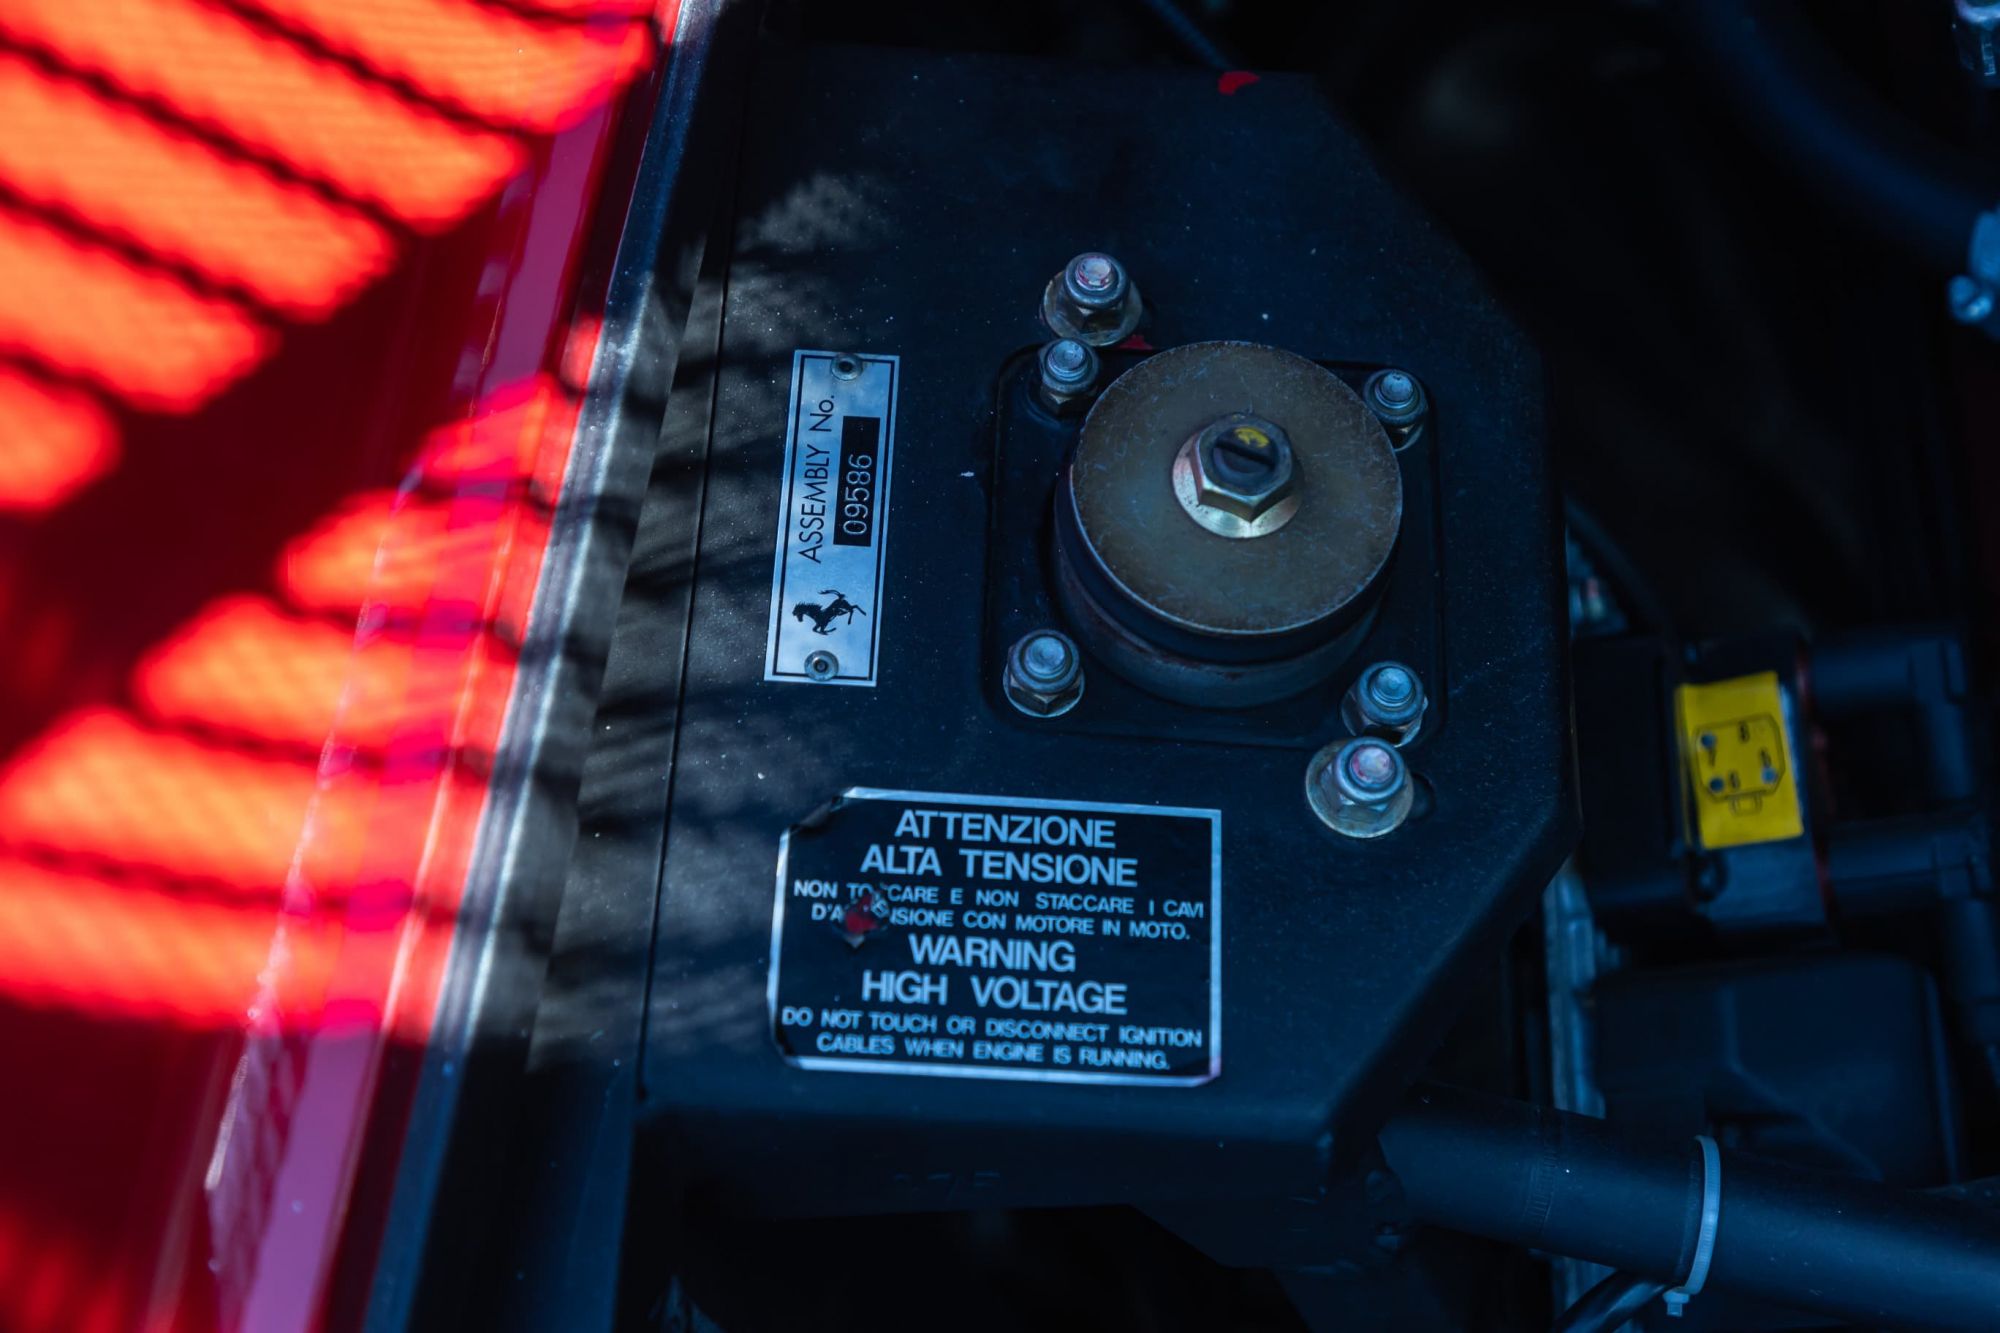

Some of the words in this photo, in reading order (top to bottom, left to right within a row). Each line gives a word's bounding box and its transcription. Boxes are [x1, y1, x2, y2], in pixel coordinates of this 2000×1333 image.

[808, 395, 835, 432] No.
[798, 443, 830, 564] ASSEMBLY
[842, 453, 873, 535] 09586
[894, 808, 1117, 849] ATTENZIONE
[859, 844, 943, 877] ALTA
[959, 847, 1139, 888] TENSIONE
[793, 880, 838, 898] NON
[846, 881, 939, 904] TOCARE
[949, 889, 963, 905] E
[975, 890, 1020, 908] NON
[1035, 891, 1135, 915] STACCARE
[1148, 900, 1155, 916] I
[1162, 900, 1205, 918] CAVI
[962, 910, 1007, 930] CON
[1015, 914, 1095, 936] MOTORE
[1102, 919, 1121, 936] IN
[1129, 921, 1191, 940] MOTO.
[908, 932, 1077, 973] WARNING
[861, 970, 948, 1005] HIGH
[970, 974, 1128, 1016] VOLTAGE
[781, 1007, 813, 1028] DO
[820, 1010, 862, 1030] NOT
[870, 1013, 938, 1033] TOUCH
[946, 1016, 977, 1034] OR
[985, 1018, 1109, 1043] DISCONNECT
[1118, 1024, 1203, 1047] IGNITION
[816, 1032, 895, 1055] CABLES
[905, 1040, 965, 1059] WHEN
[973, 1042, 1044, 1063] ENGINE
[1052, 1045, 1071, 1064] IS
[1079, 1046, 1170, 1070] RUNNING.
